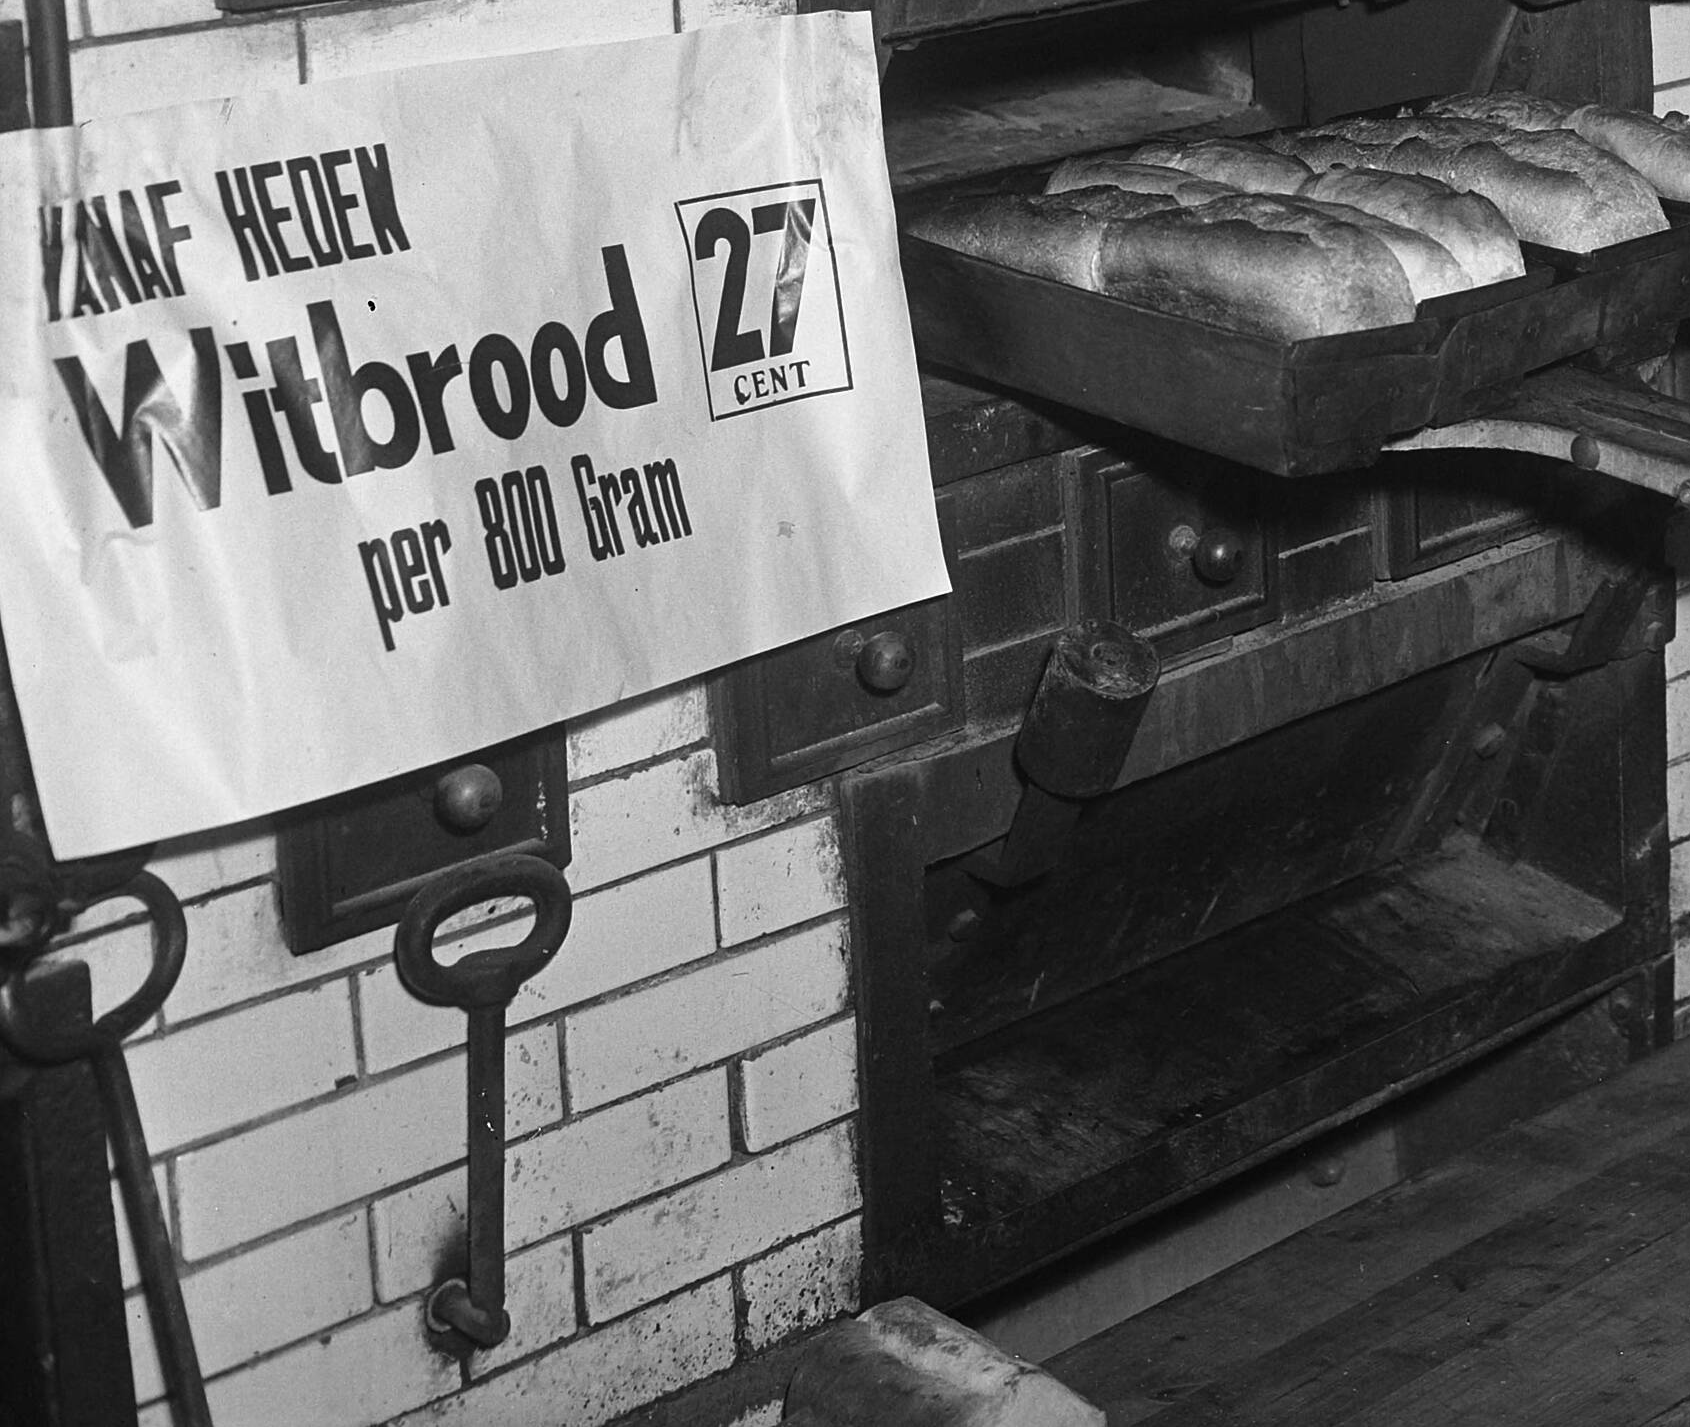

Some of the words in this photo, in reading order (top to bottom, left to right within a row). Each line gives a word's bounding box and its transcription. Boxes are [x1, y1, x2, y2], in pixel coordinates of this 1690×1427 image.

[39, 179, 194, 324] VANAF
[215, 142, 412, 283] HEDEN
[693, 198, 817, 372] 27
[54, 245, 659, 530] Witbrood
[733, 359, 812, 406] CENT
[357, 516, 453, 652] per
[474, 466, 567, 593] 800
[571, 453, 693, 563] Gram
